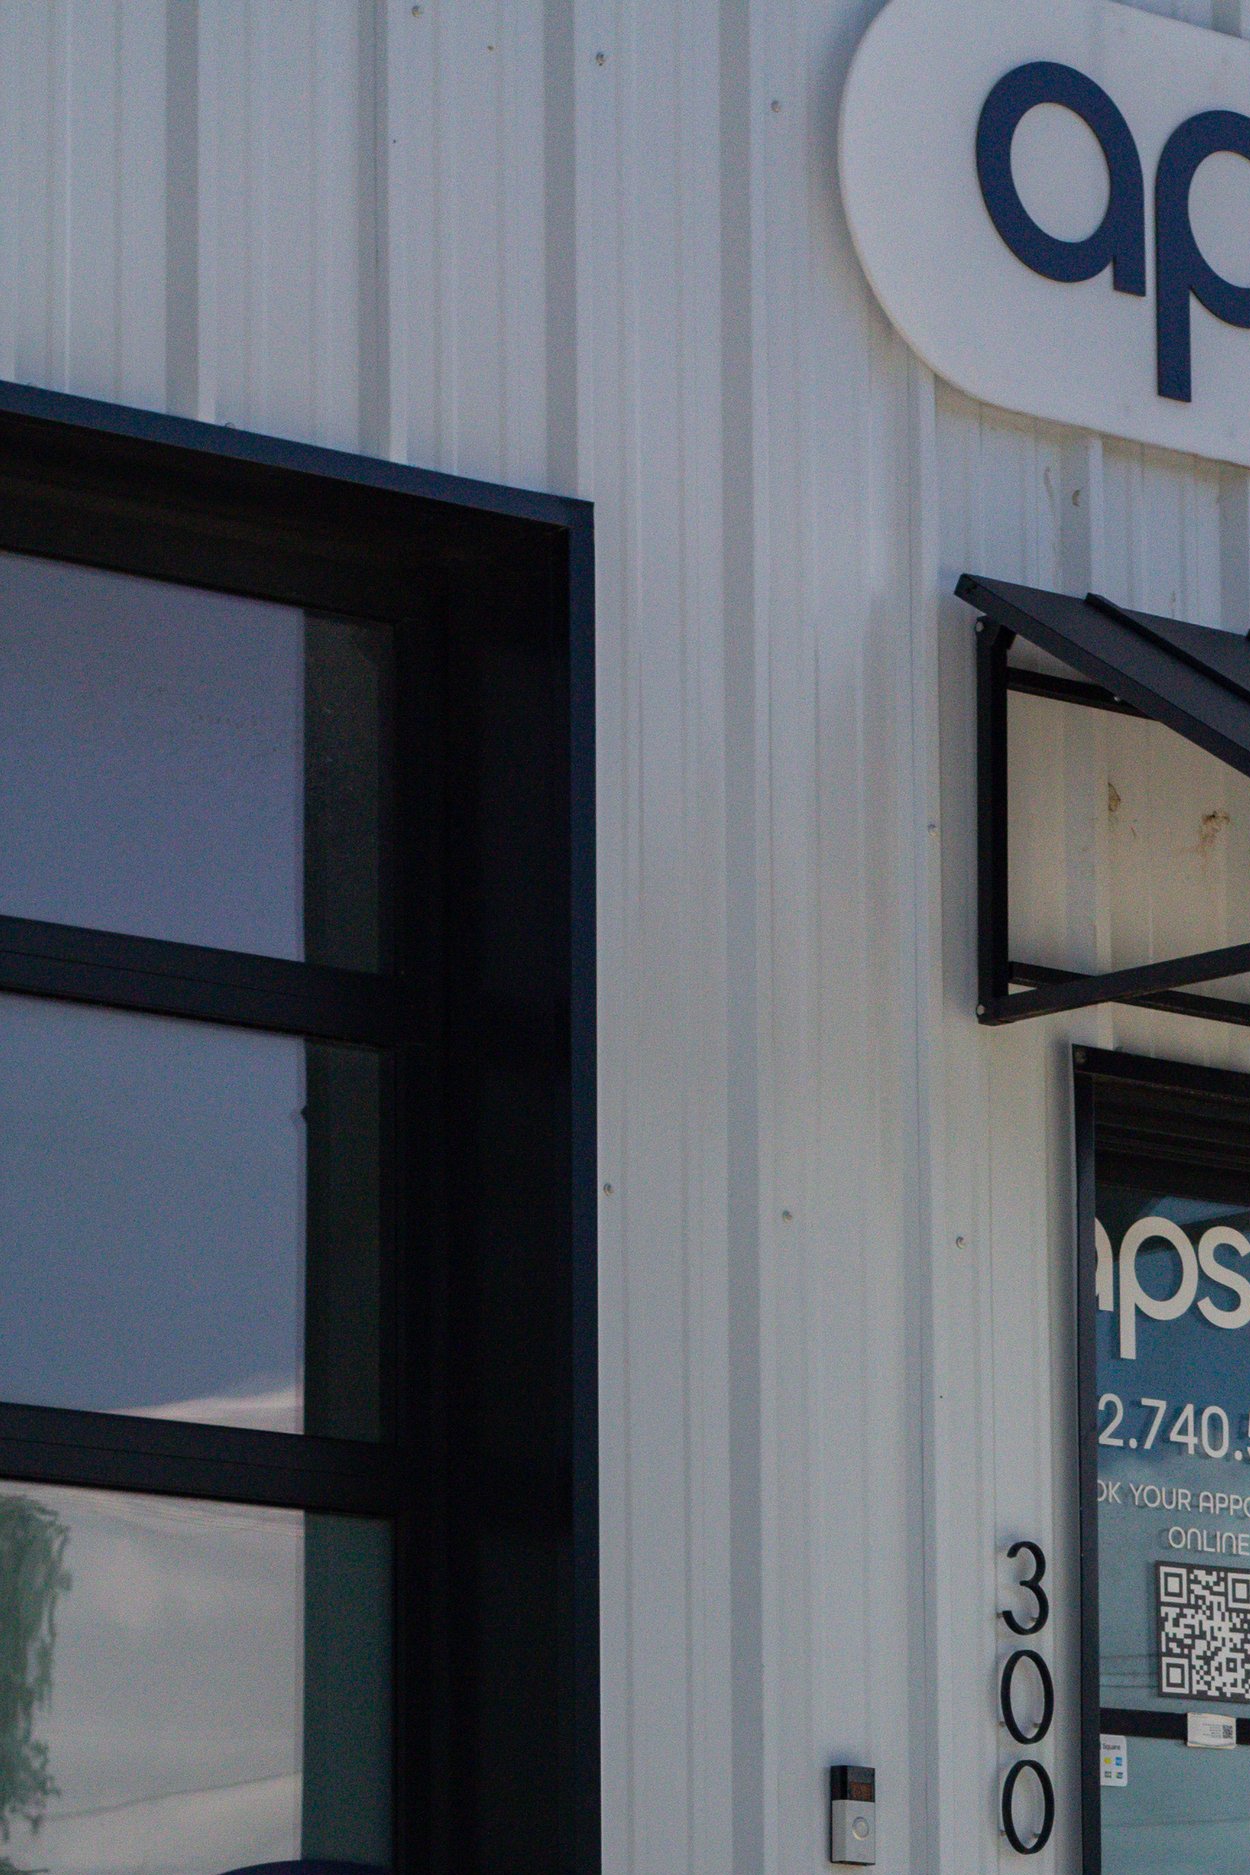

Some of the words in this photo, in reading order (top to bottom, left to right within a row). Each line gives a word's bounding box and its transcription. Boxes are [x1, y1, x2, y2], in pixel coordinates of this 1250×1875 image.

[1129, 1482, 1192, 1511] YOUR
[1168, 1526, 1250, 1556] ONLINE
[1001, 1540, 1055, 1855] 300
